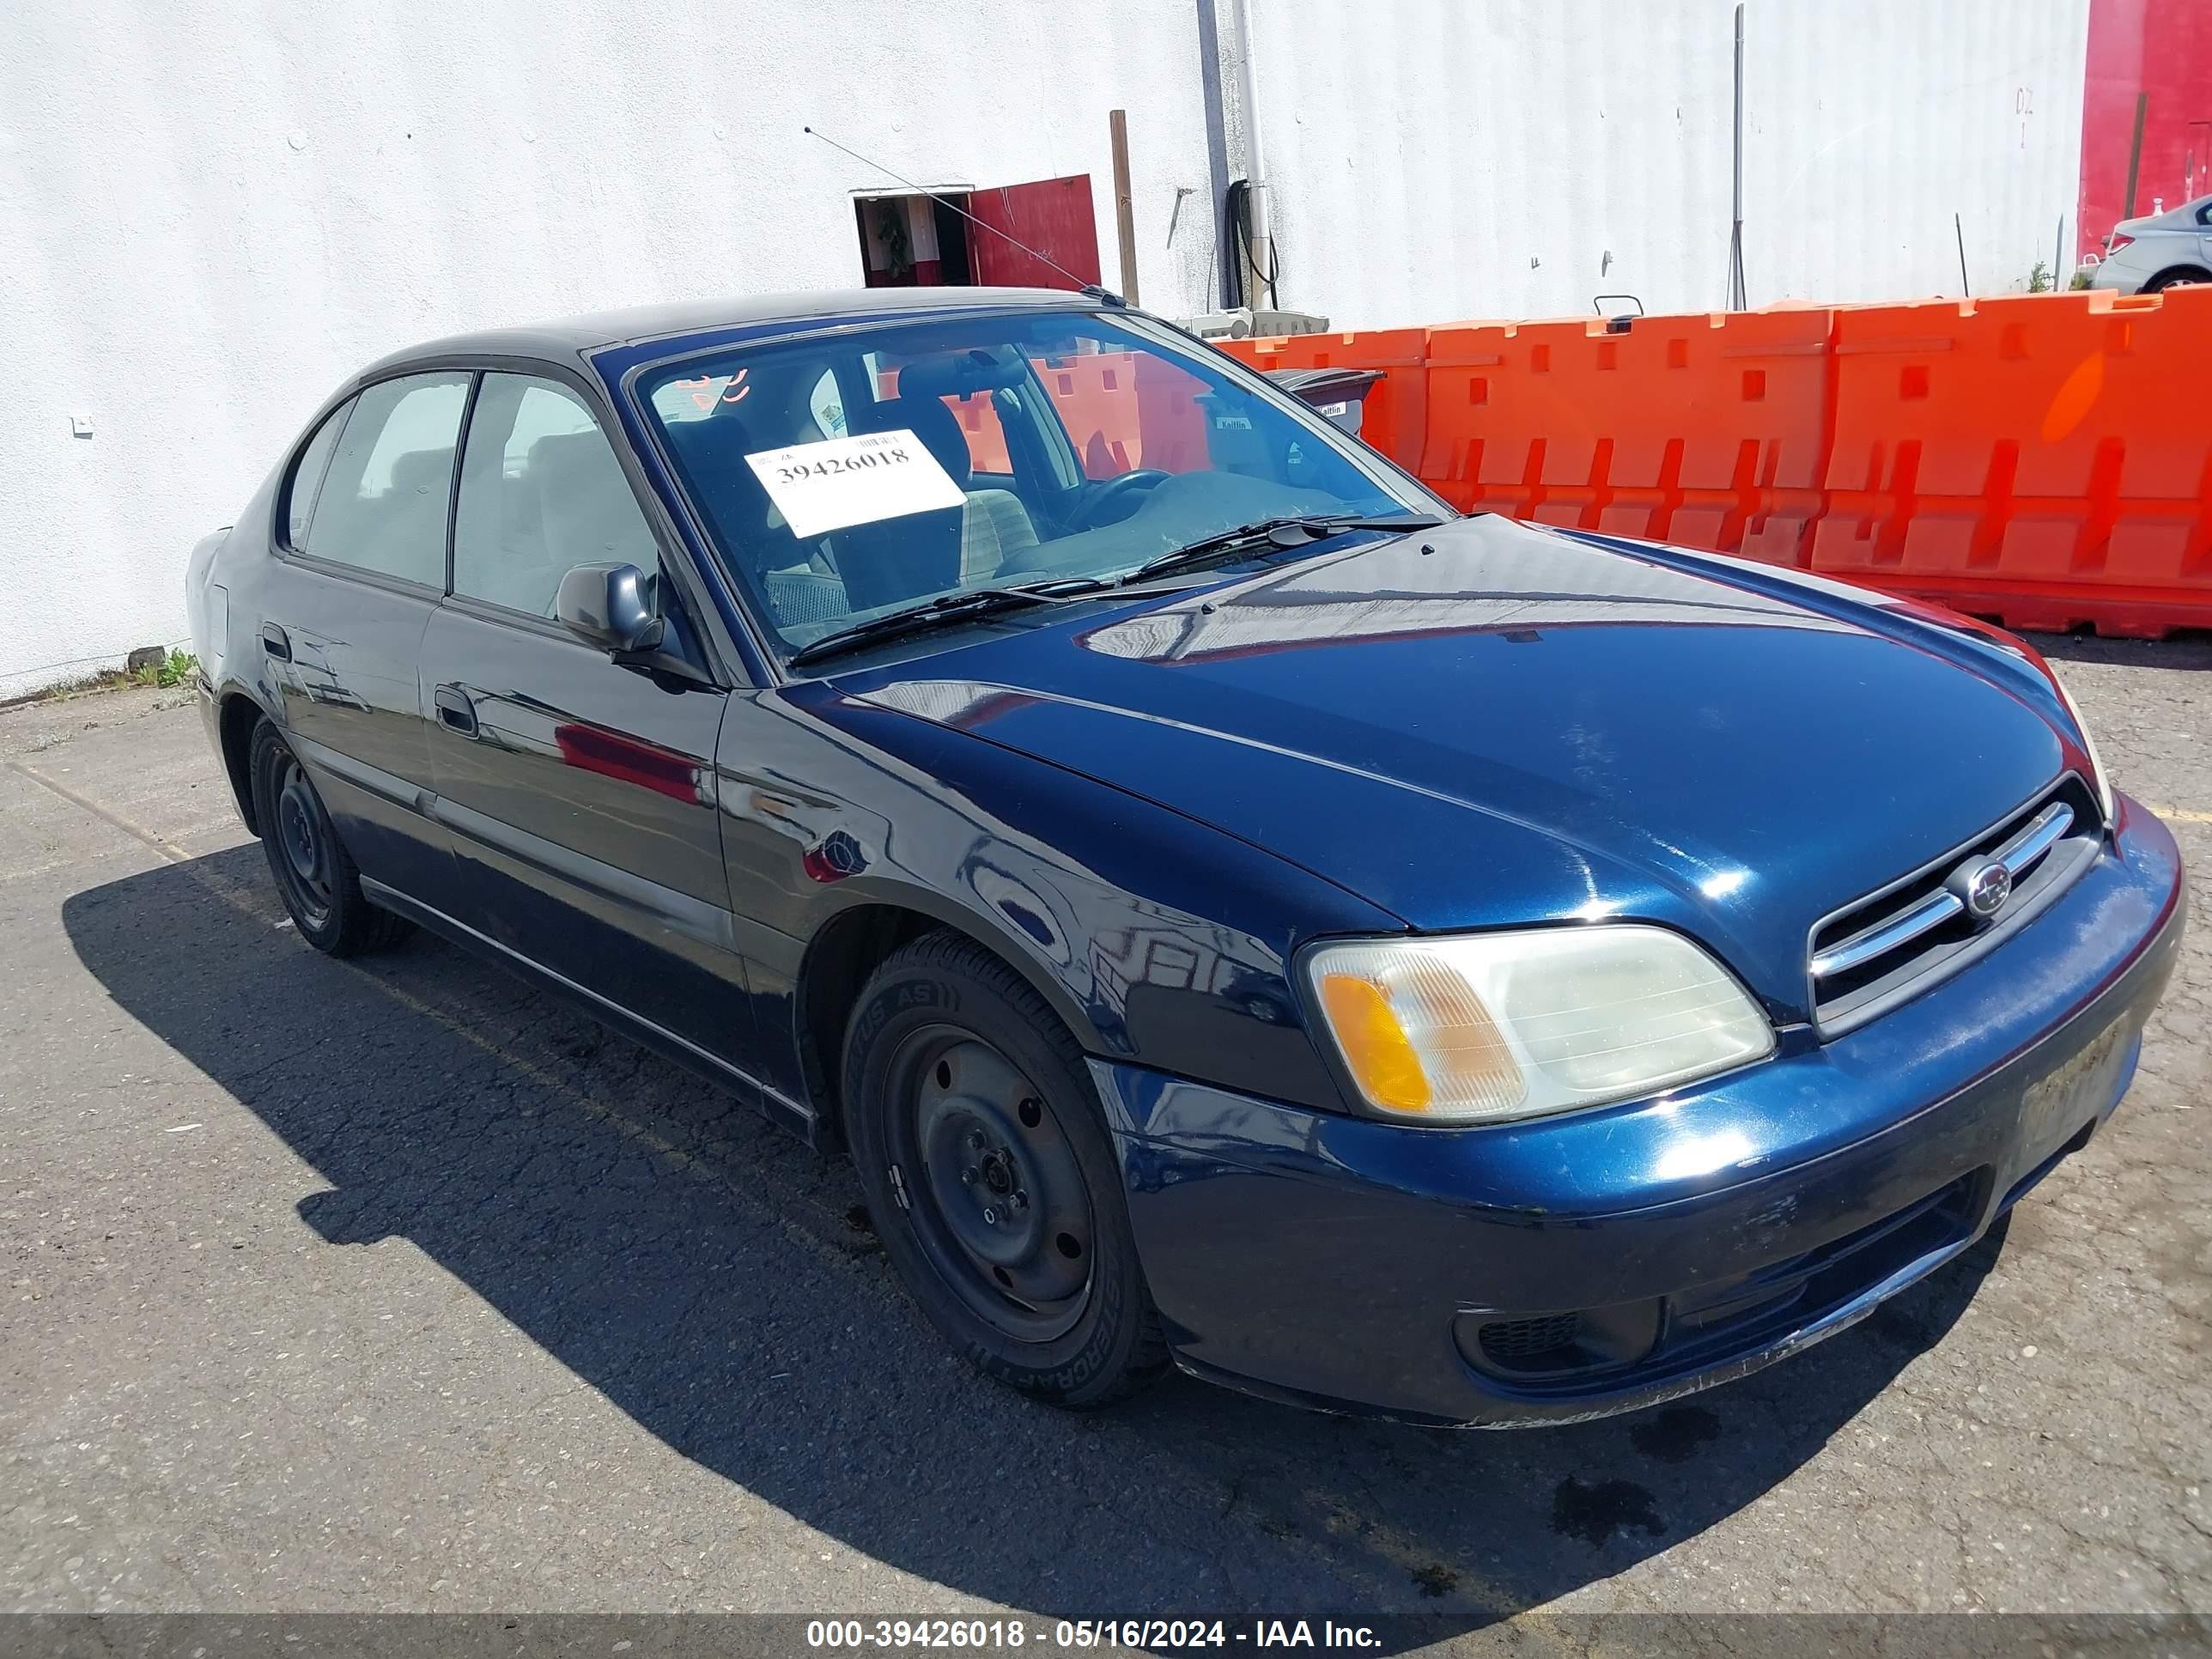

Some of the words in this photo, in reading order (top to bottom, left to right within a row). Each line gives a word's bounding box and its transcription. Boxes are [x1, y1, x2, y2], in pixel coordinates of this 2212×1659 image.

[1222, 420, 1246, 429] Kaitlin
[776, 448, 909, 483] 39426018
[995, 1243, 1121, 1389] ASTERCRAFT
